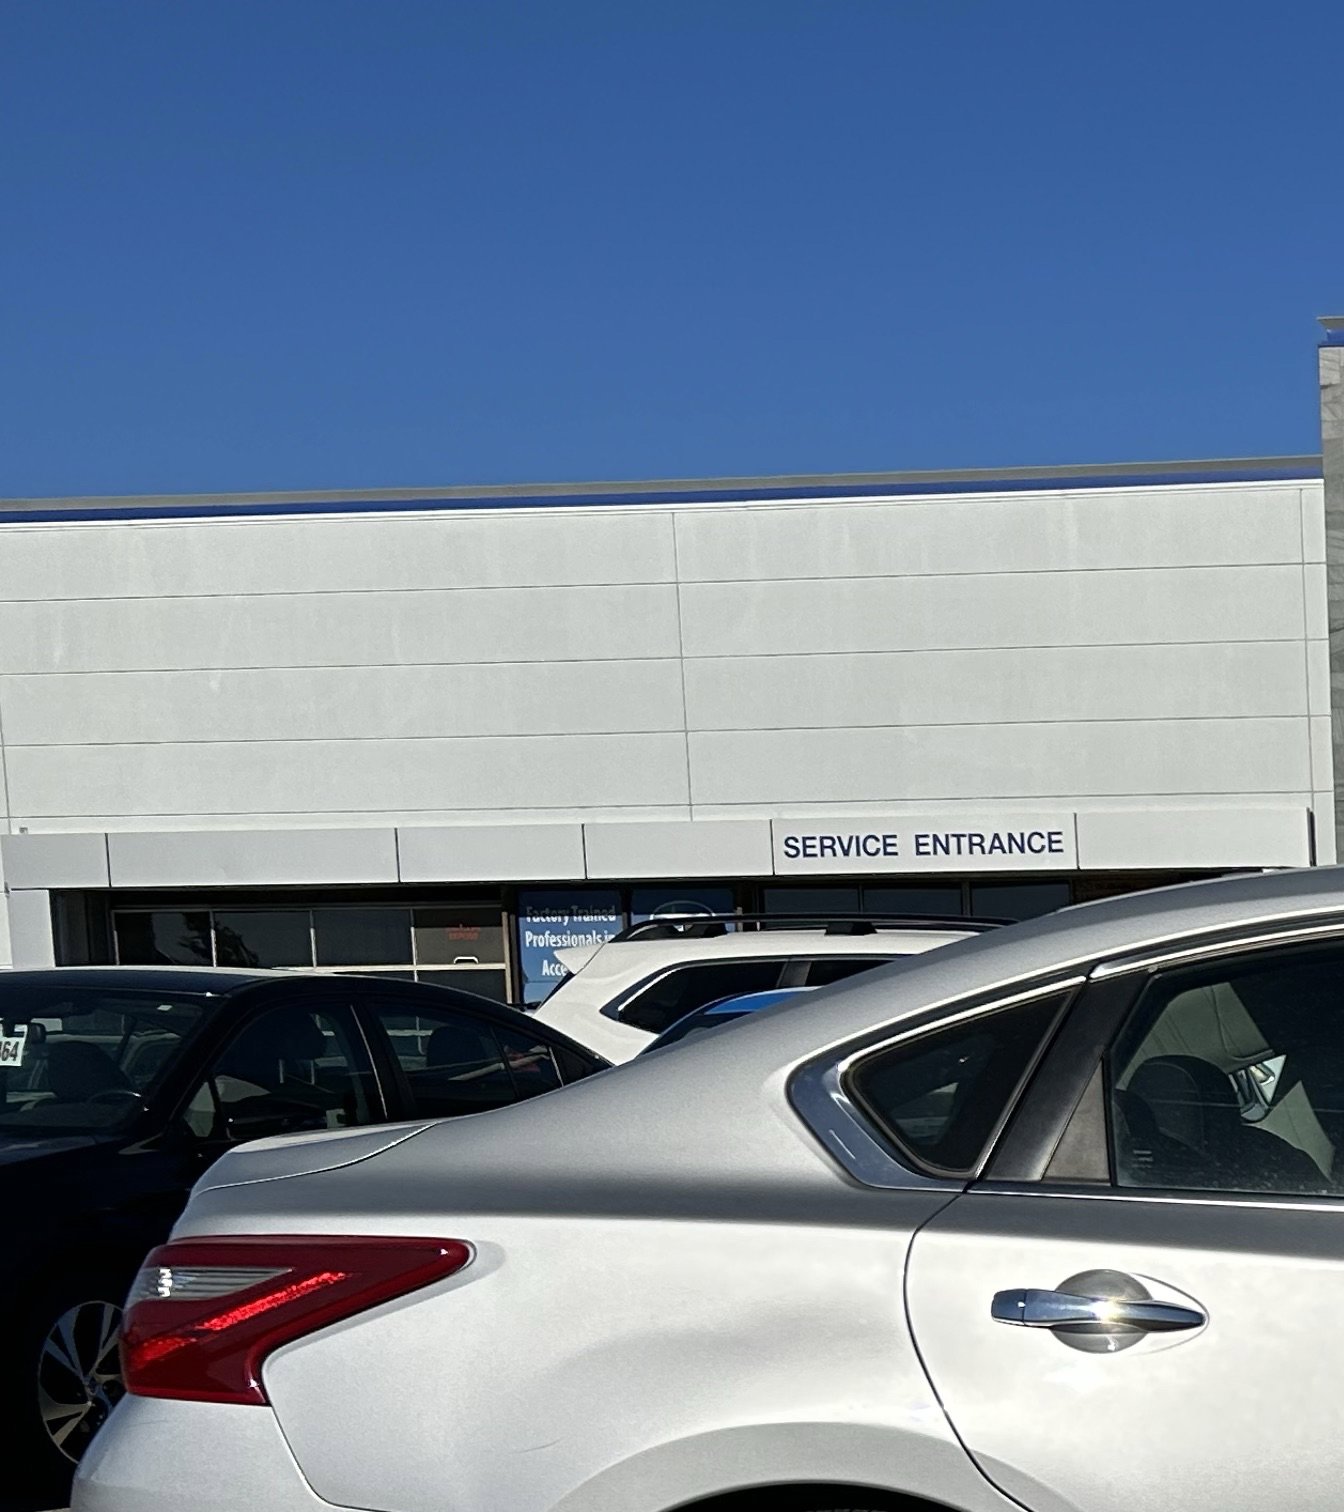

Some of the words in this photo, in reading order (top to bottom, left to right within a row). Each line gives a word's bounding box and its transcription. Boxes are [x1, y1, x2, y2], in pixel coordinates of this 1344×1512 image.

[784, 834, 899, 858] SERVICE
[915, 831, 1065, 856] ENTRANCE
[526, 905, 569, 926] Factory
[571, 905, 616, 922] Trained
[525, 929, 602, 948] Professionals
[0, 1040, 20, 1062] 64
